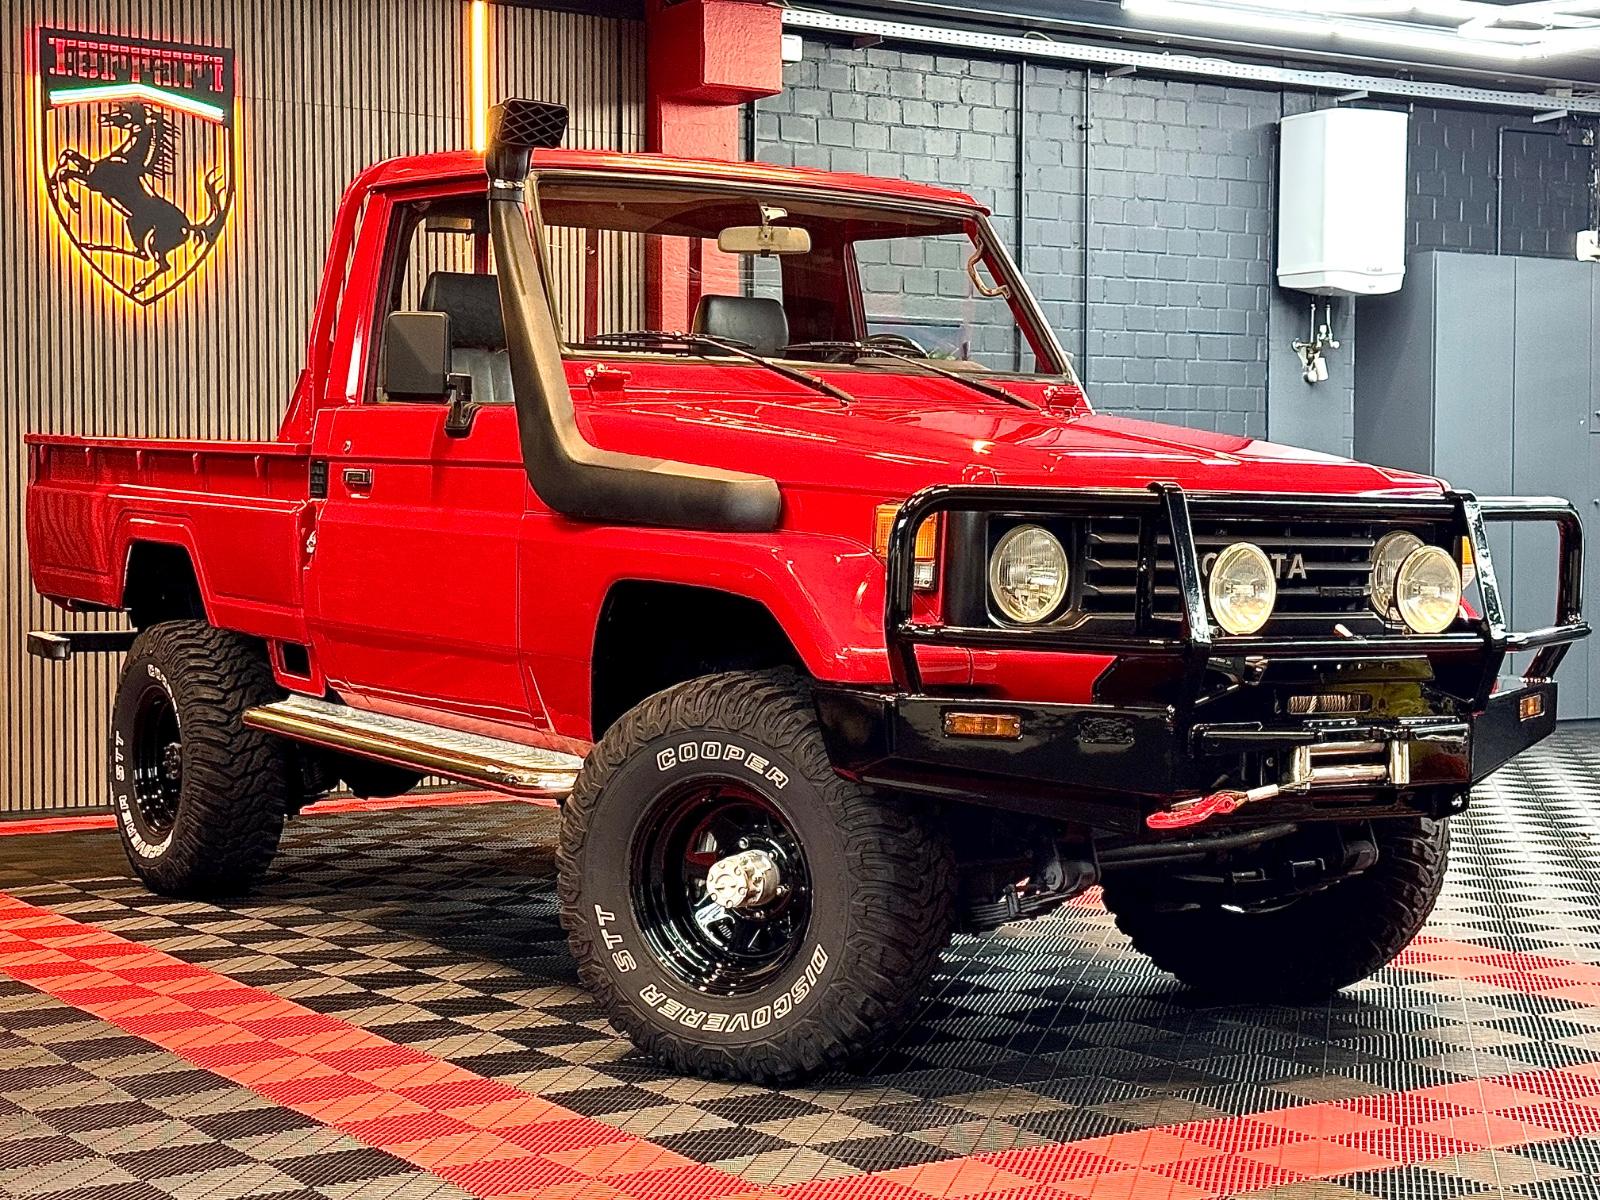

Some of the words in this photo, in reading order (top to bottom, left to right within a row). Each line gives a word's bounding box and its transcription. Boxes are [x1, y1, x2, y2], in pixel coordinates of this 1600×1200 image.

[48, 37, 223, 92] Ferrari
[1201, 551, 1308, 580] OTA
[115, 730, 125, 782] STT
[656, 741, 789, 790] COOPER
[594, 904, 637, 973] STT
[639, 943, 829, 1033] DISCOVERER
